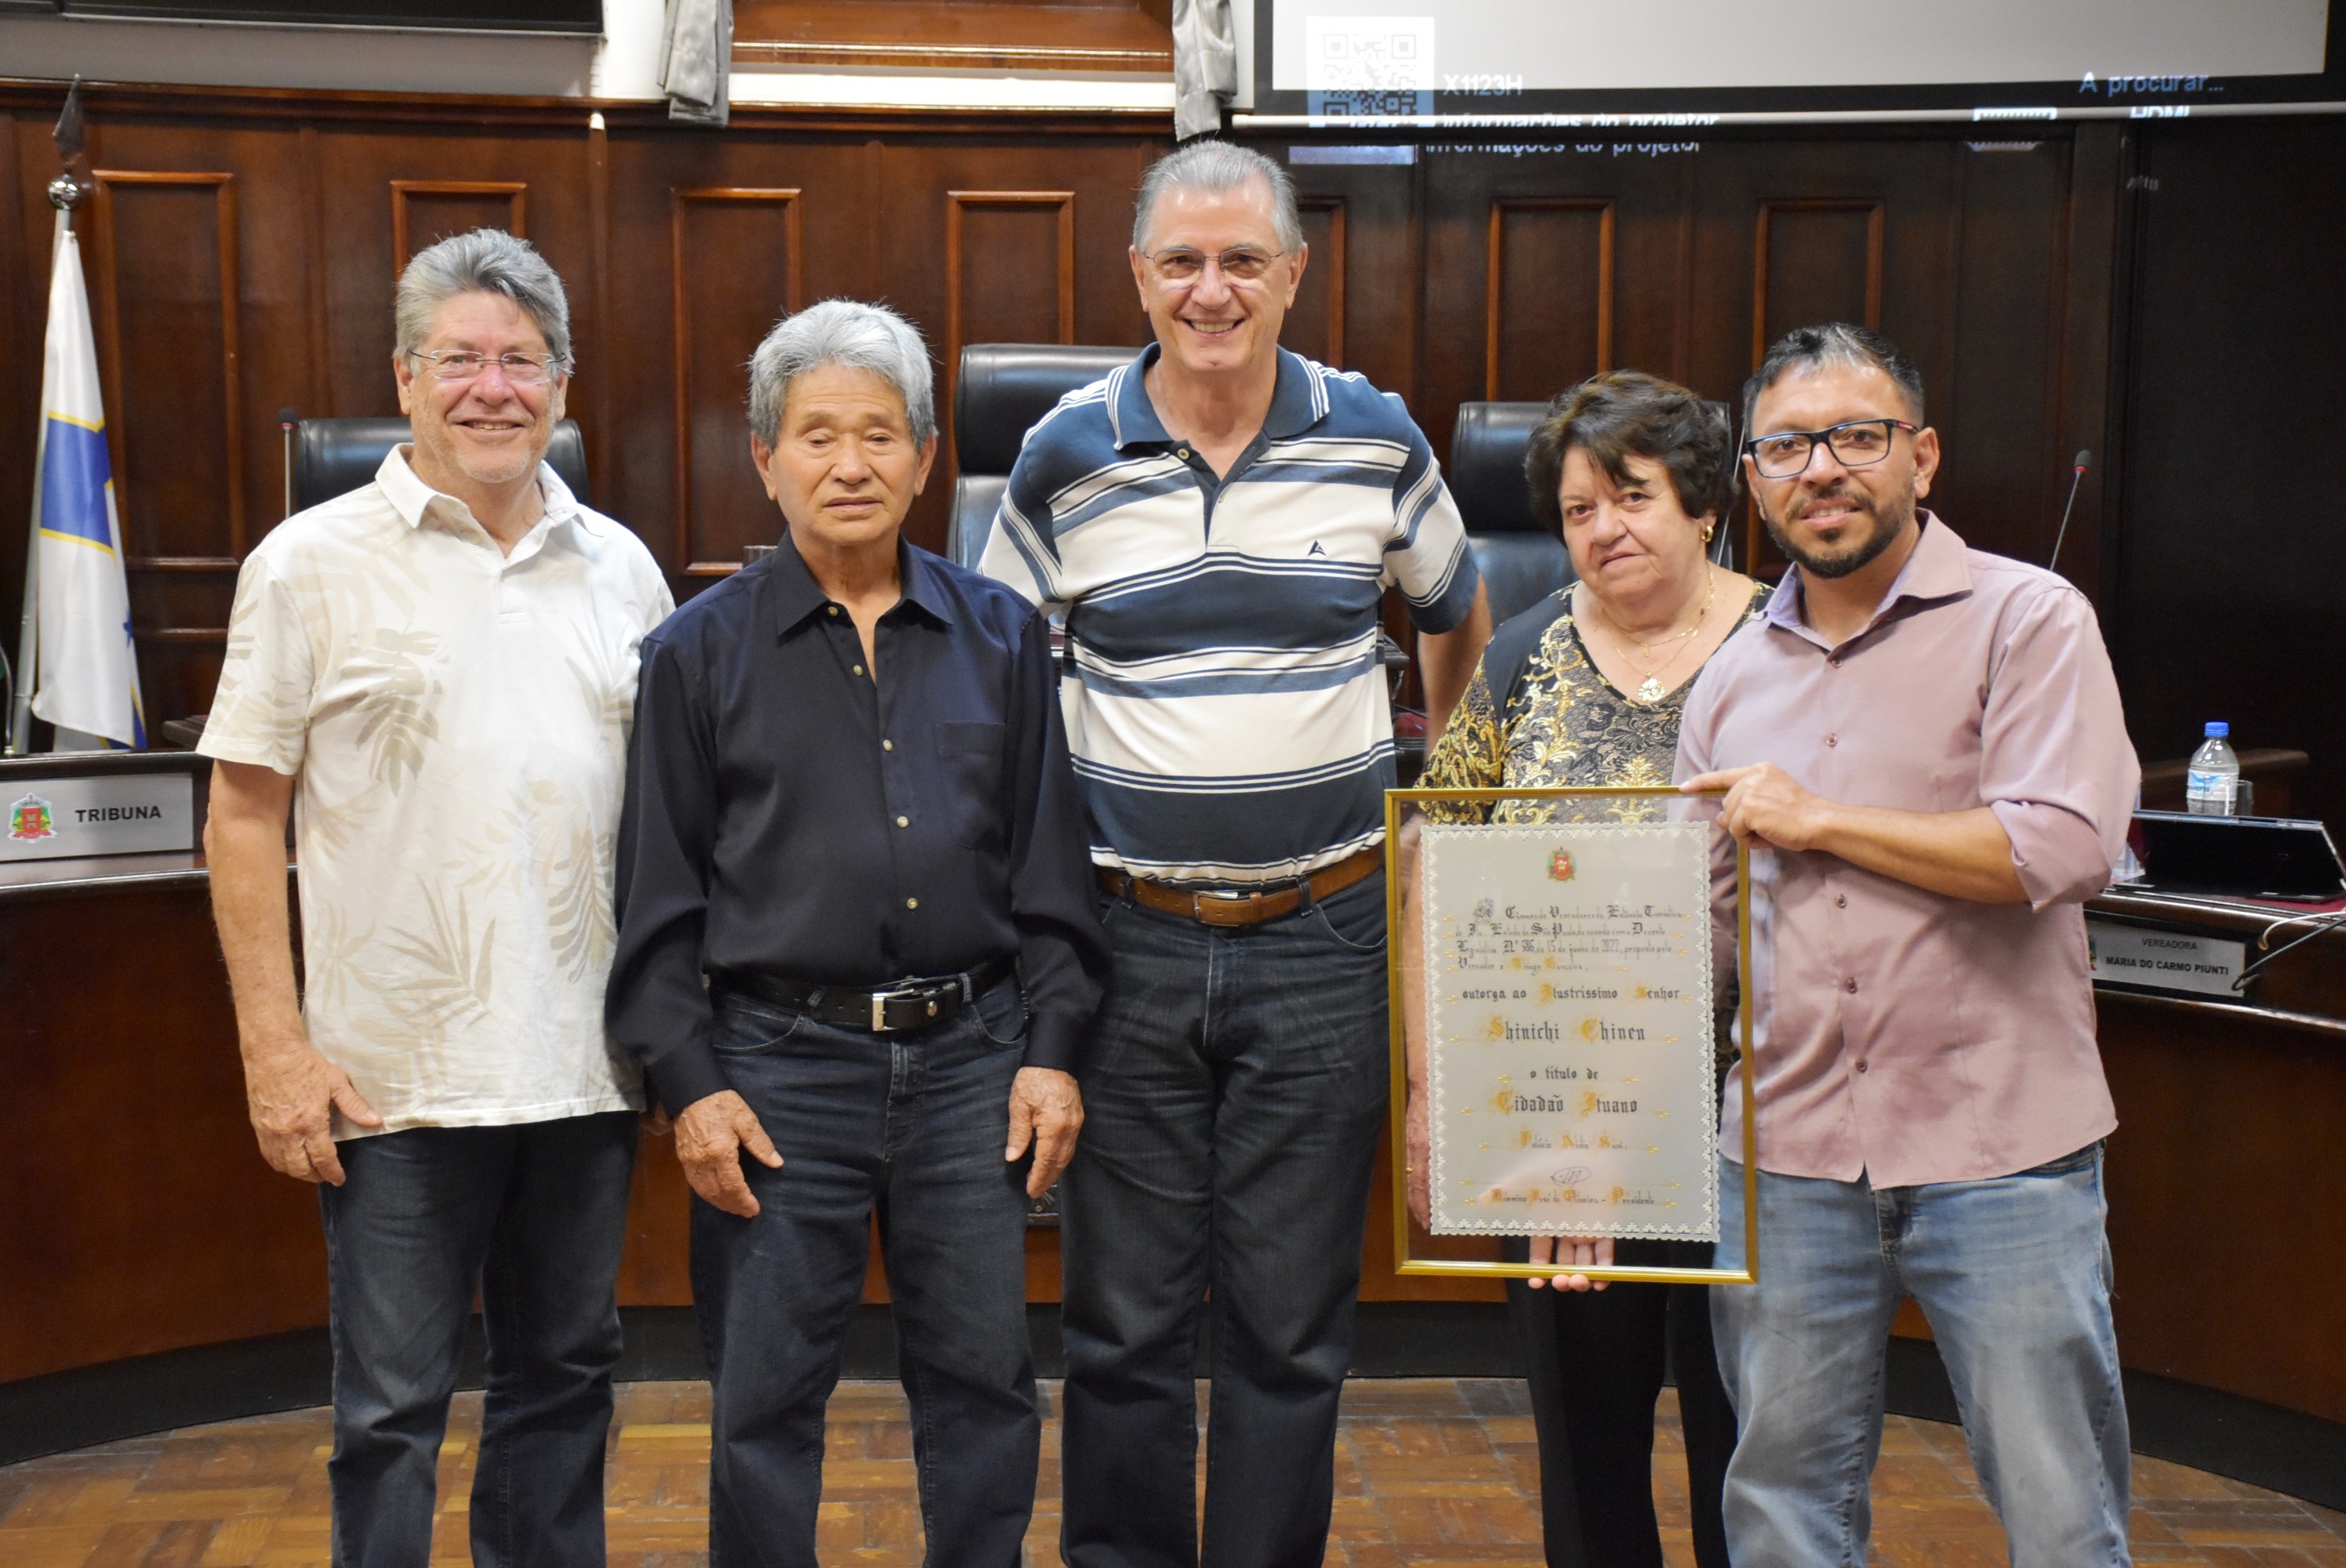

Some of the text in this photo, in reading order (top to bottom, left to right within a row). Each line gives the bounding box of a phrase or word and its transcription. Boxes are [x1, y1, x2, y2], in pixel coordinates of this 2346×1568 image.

[1443, 74, 1523, 96] X1123H
[2079, 71, 2097, 93] A
[75, 805, 162, 823] TRIBUNA
[2141, 938, 2198, 950] VEREADORA
[2105, 956, 2229, 975] MARIA DO CARMO PIUNTI
[1462, 987, 1506, 1002] outorga
[1513, 988, 1527, 999] ao
[1635, 985, 1681, 1003] Senhor
[1489, 1017, 1646, 1044] Shinichi Chinen
[1586, 1068, 1599, 1080] de
